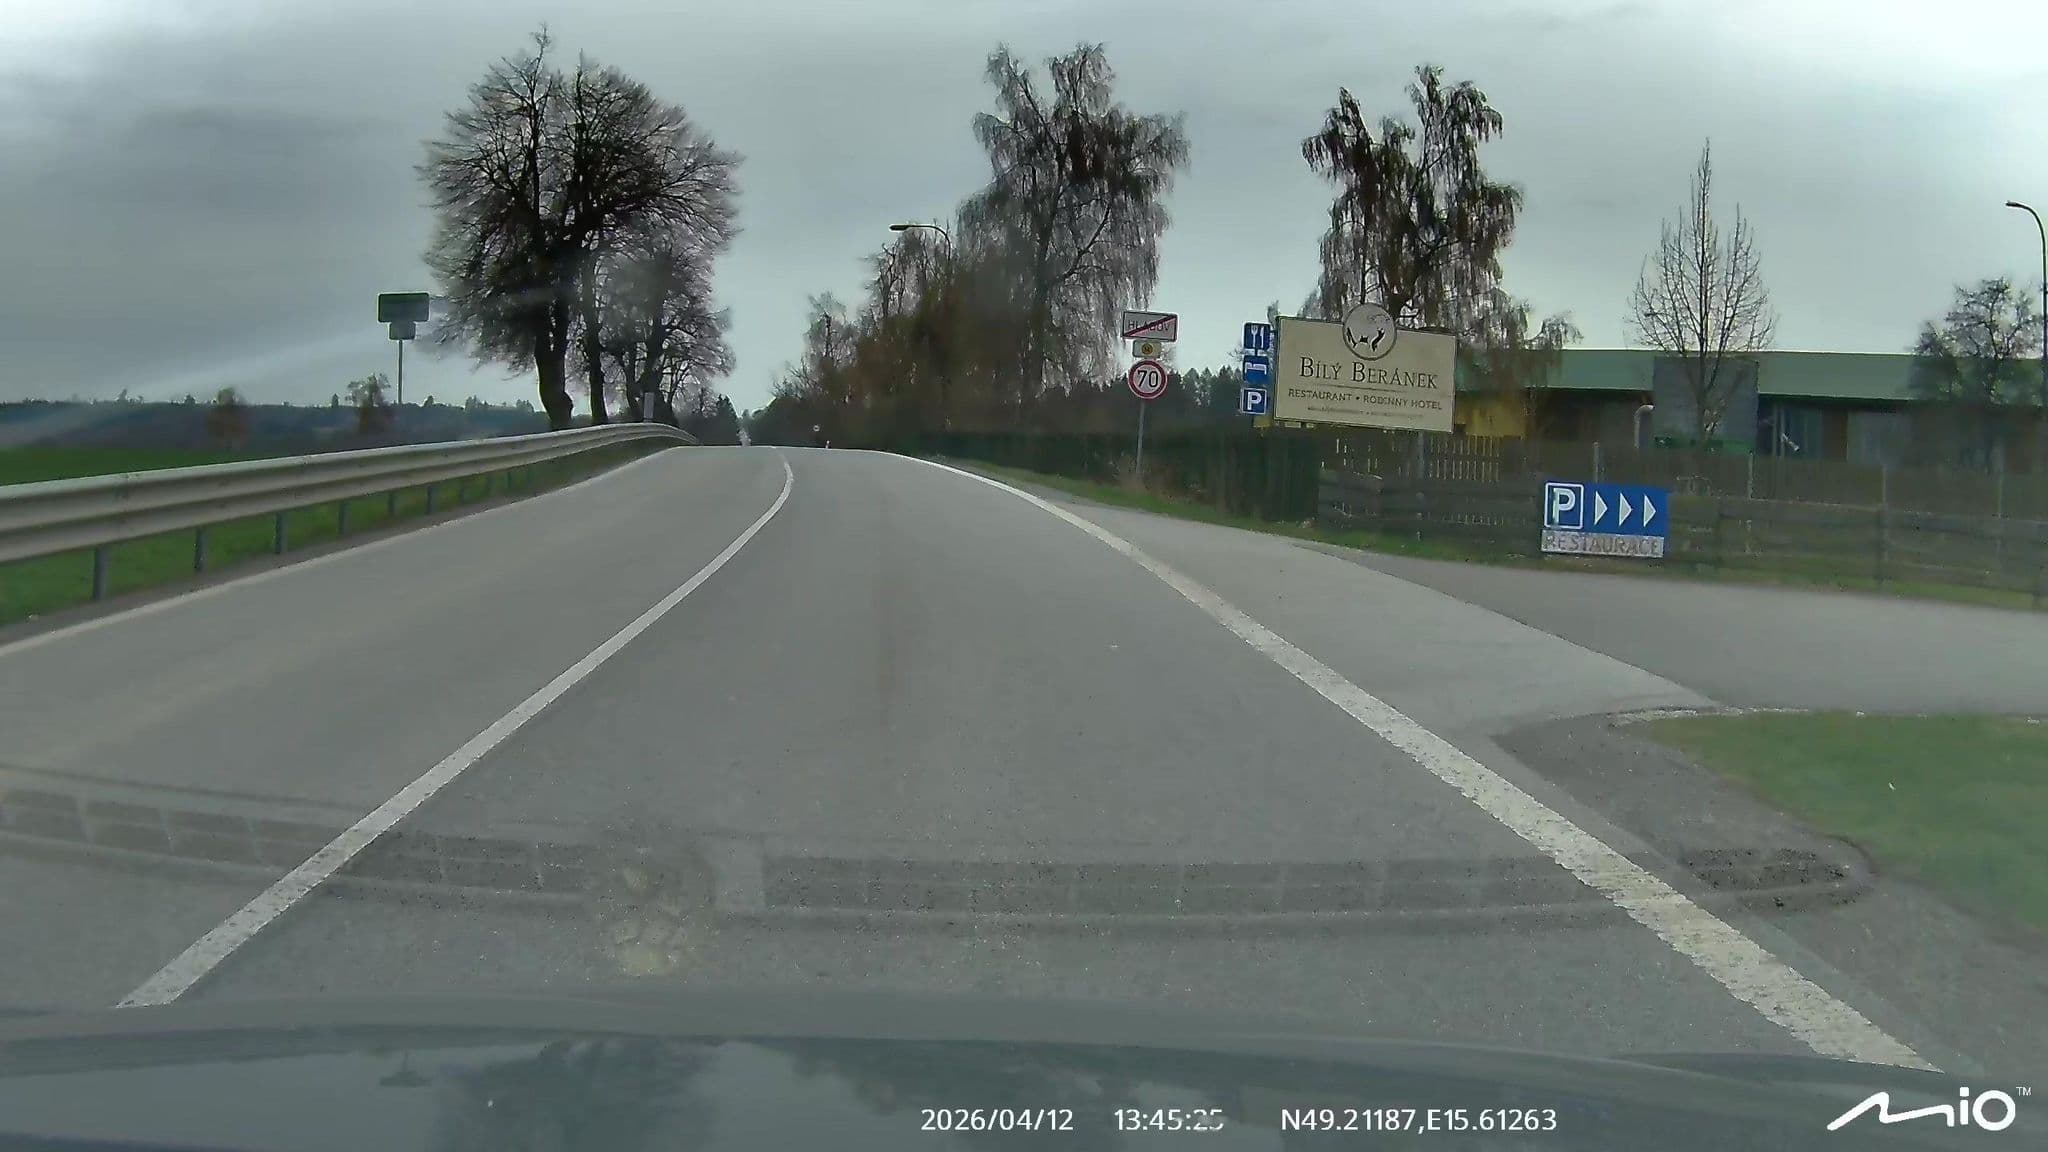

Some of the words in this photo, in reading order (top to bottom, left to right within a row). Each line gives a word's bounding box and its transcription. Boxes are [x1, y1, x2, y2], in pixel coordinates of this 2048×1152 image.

[1137, 370, 1158, 388] 70
[1247, 391, 1261, 410] P
[1288, 389, 1353, 402] RESTAURANT
[1411, 398, 1443, 411] HOTEL
[1552, 488, 1576, 525] P
